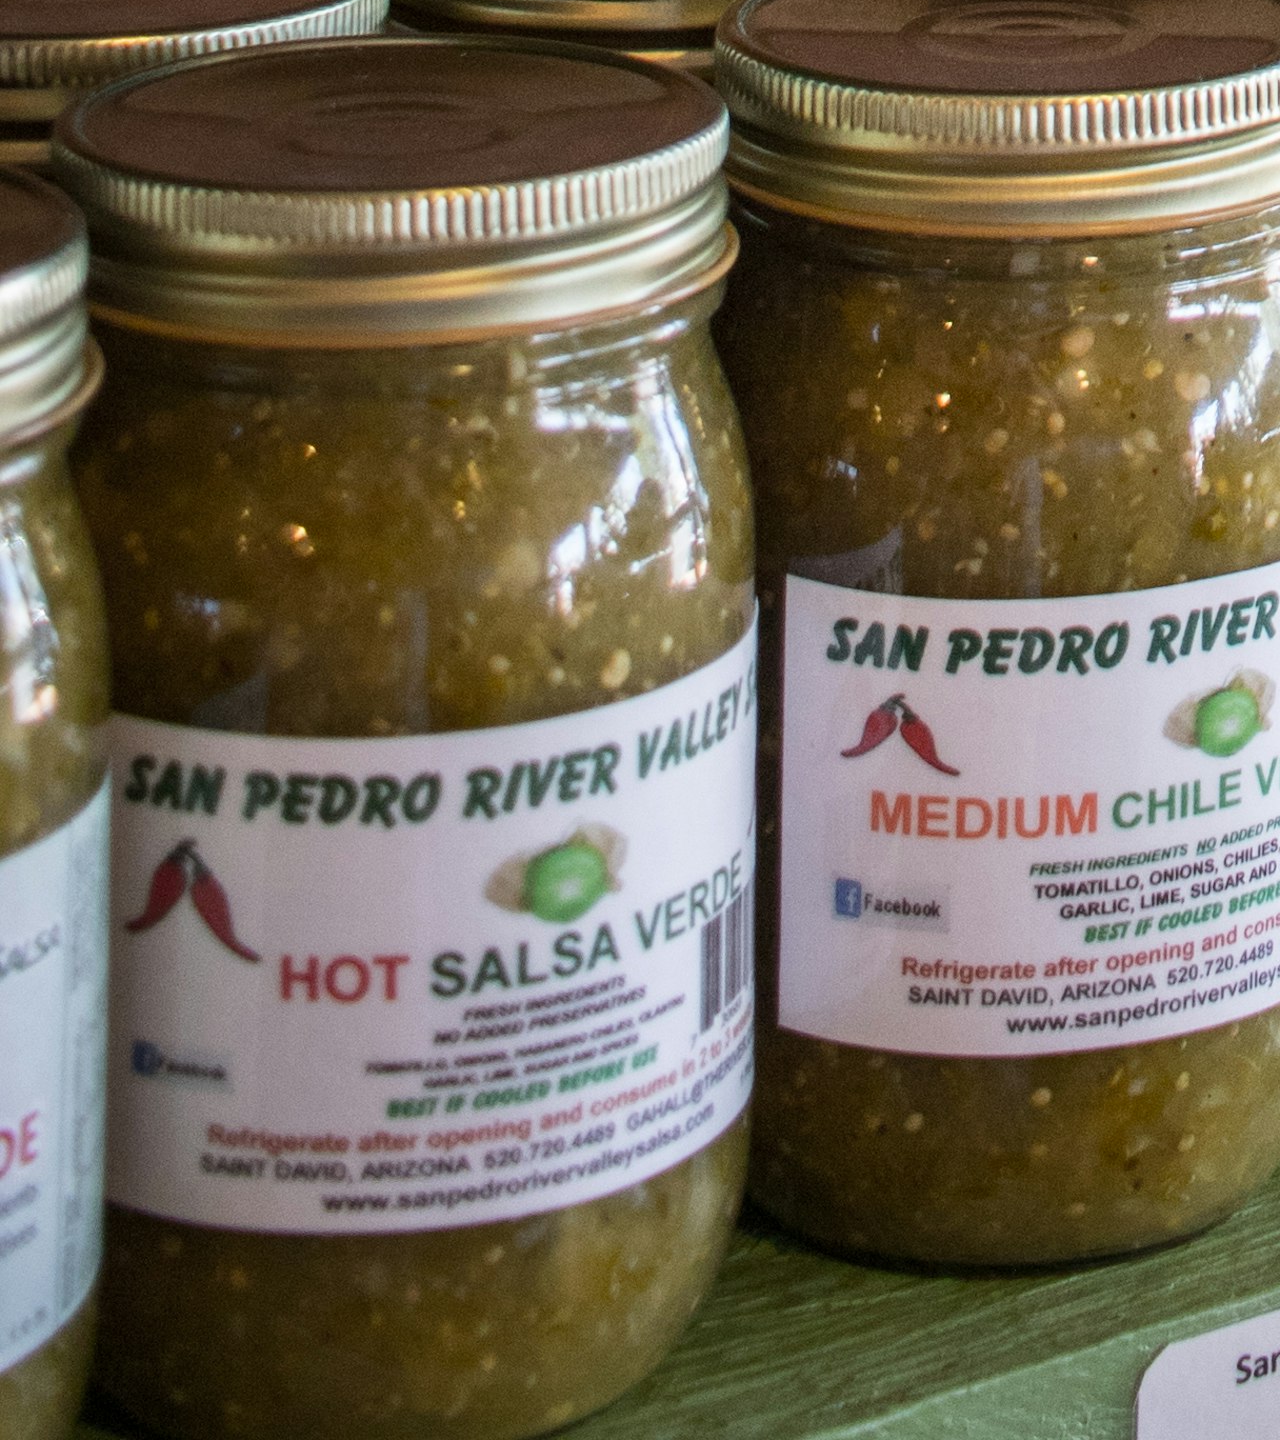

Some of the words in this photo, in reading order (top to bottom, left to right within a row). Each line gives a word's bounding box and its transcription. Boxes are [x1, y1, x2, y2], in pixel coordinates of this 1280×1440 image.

[827, 617, 929, 672] SAN
[945, 618, 1129, 676] PEDRO
[1146, 592, 1280, 665] RIVER
[125, 754, 225, 815] SAN
[242, 771, 441, 827] PEDRO
[462, 744, 621, 821] RIVER
[637, 678, 742, 781] VALLEY
[869, 791, 1099, 841] MEDIUM
[1112, 768, 1244, 829] CHILE
[1029, 861, 1083, 877] FRESH
[1087, 844, 1188, 872] INGREDIENTS
[1221, 824, 1263, 847] ADDED
[1034, 876, 1144, 899] TOMATILLO,
[1150, 860, 1219, 886] ONIONS,
[1223, 838, 1280, 868] CHILIES,
[863, 893, 942, 920] Facebook
[1060, 900, 1135, 920] GARLIC,
[1140, 889, 1184, 910] LIME,
[1191, 873, 1245, 899] SUGAR
[1249, 861, 1277, 881] AND
[1084, 921, 1129, 944] BEST
[1158, 901, 1222, 932] COOLED
[280, 956, 409, 1003] HOT
[430, 924, 621, 999] SALSA
[635, 848, 742, 952] VERDE
[901, 956, 1037, 985] Refrigerate
[1044, 955, 1097, 980] after
[1106, 938, 1195, 973] opening
[1202, 925, 1238, 953] and
[907, 985, 974, 1007] SAINT
[981, 983, 1054, 1009] DAVID,
[1061, 975, 1157, 1003] ARIZONA
[1167, 940, 1274, 987] 520.720.4489
[207, 1123, 349, 1157] Refrigerate
[357, 1130, 418, 1153] after
[427, 1118, 532, 1150] opening
[540, 1101, 582, 1131] and
[590, 1071, 677, 1117] consume
[322, 1102, 714, 1213] www.sanpedrorivervalleysalsa.com
[360, 1154, 471, 1180] ARIZONA
